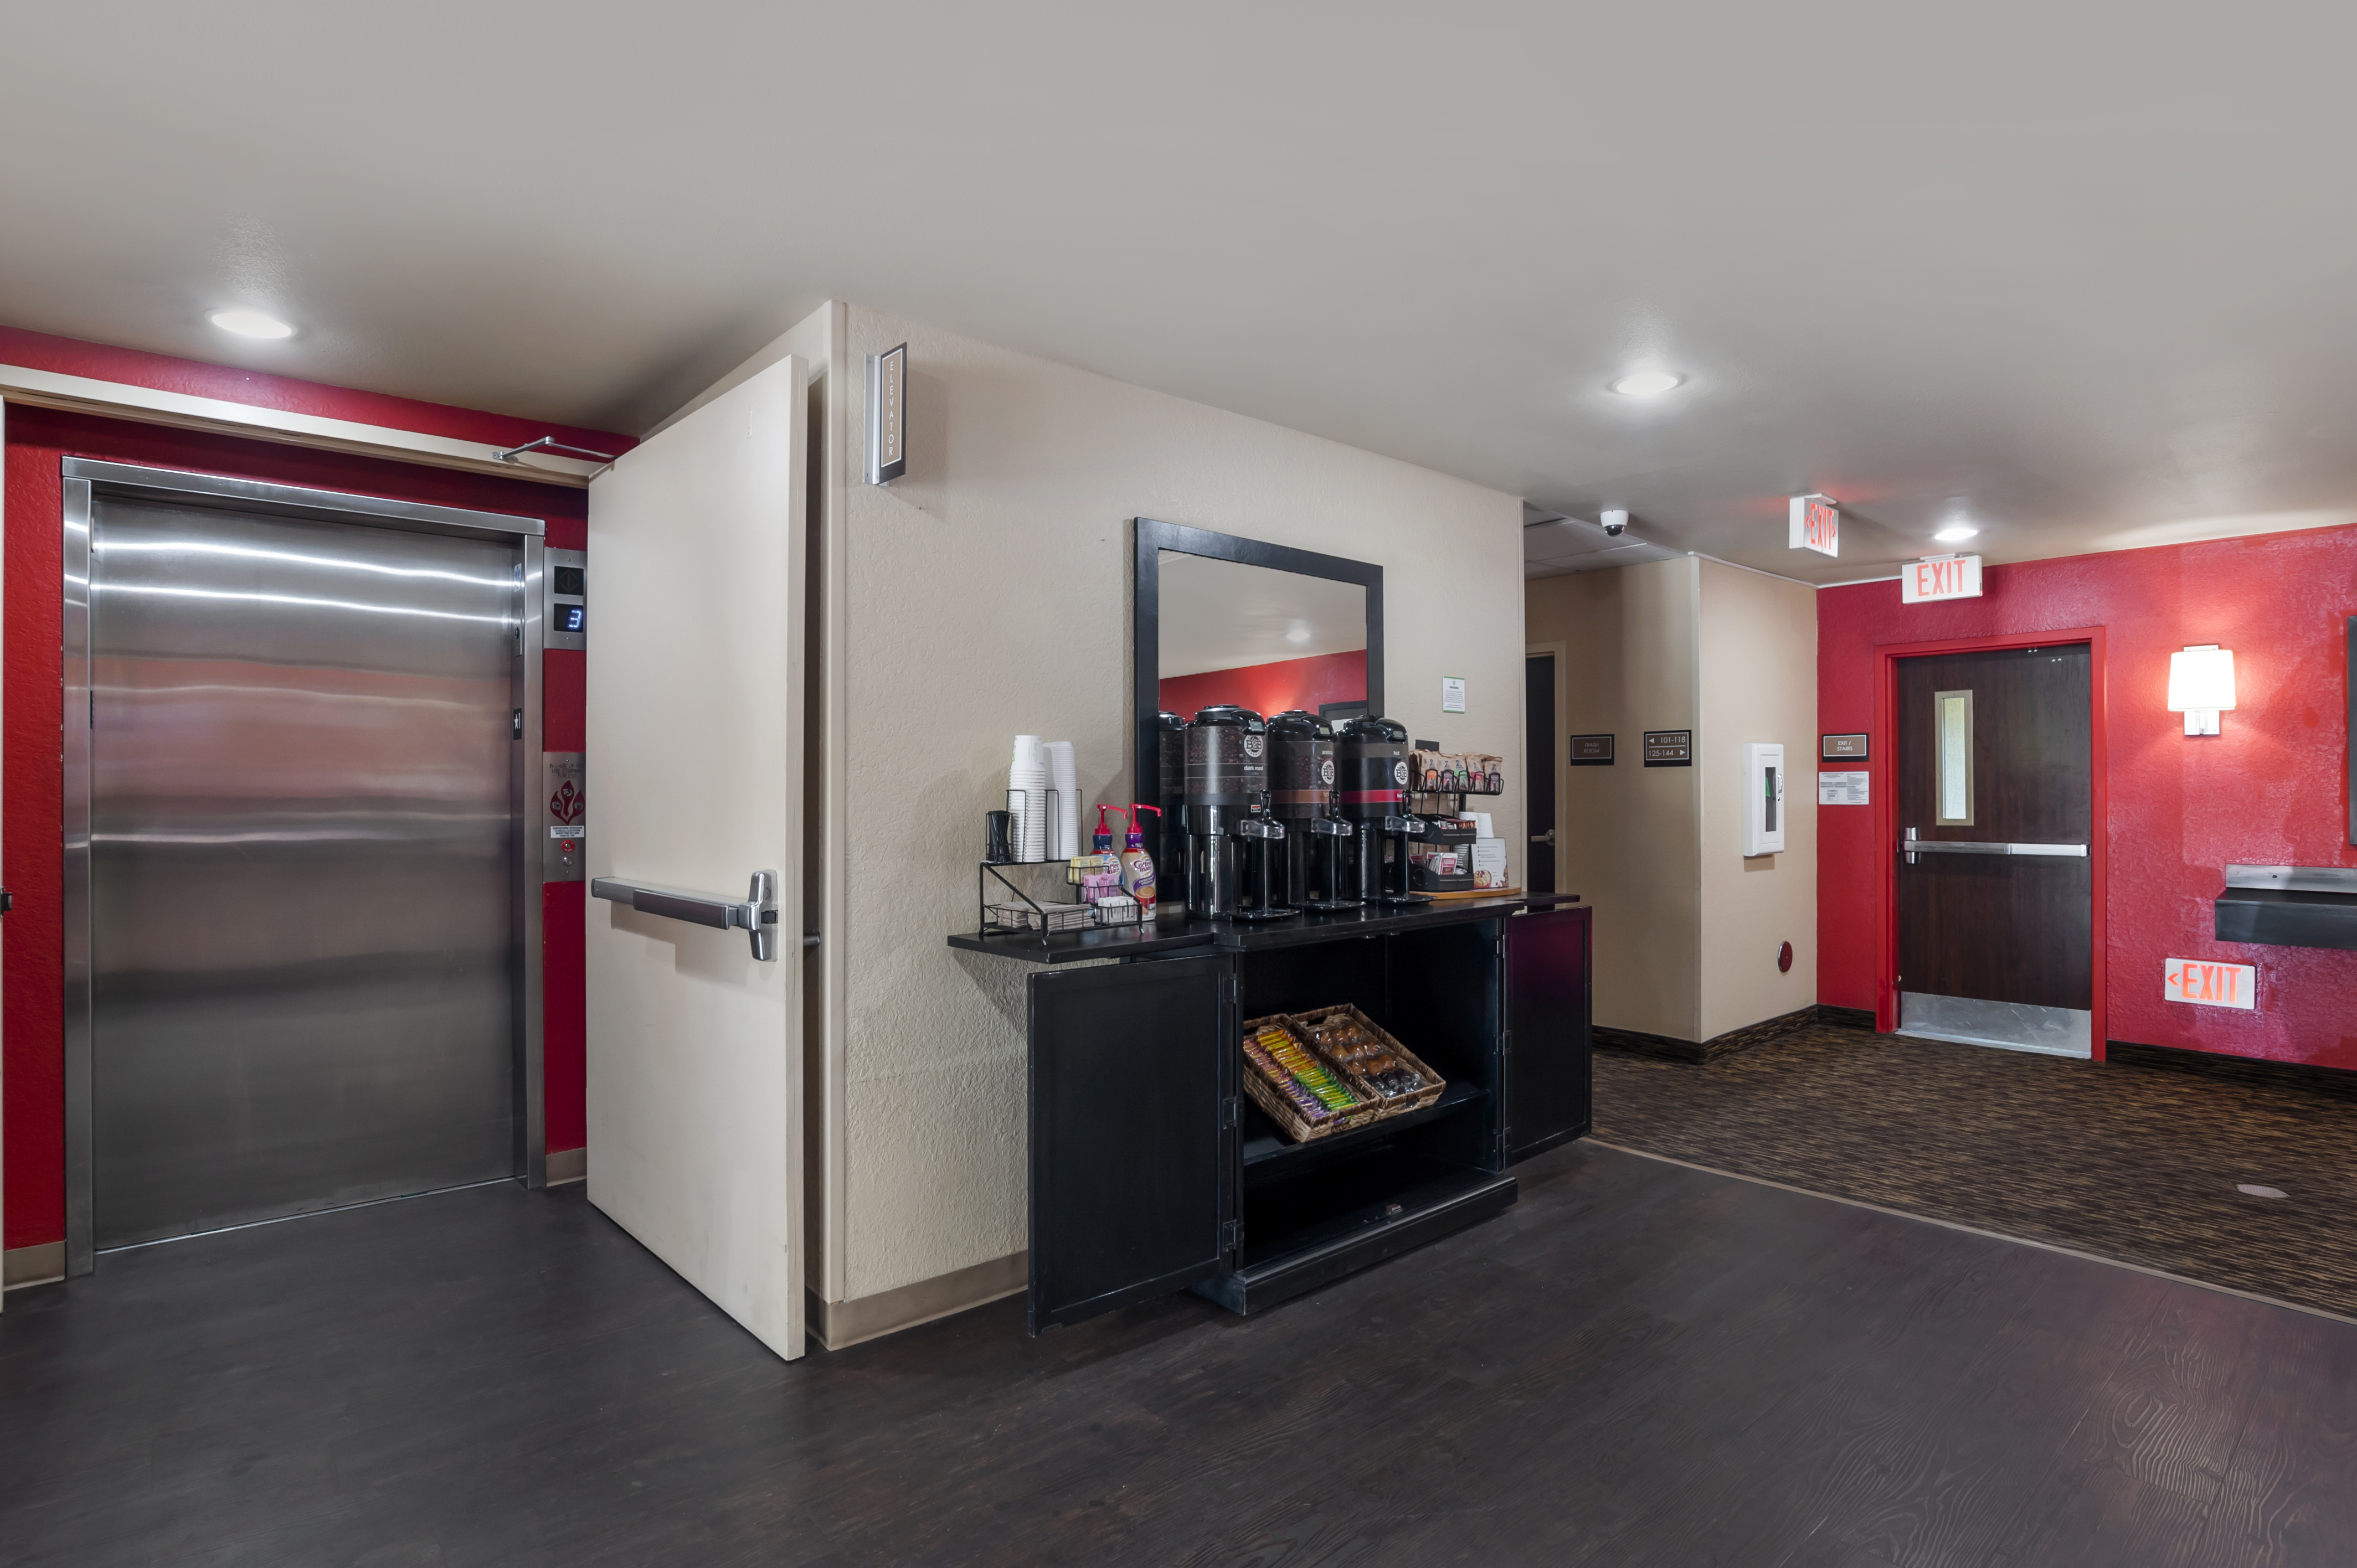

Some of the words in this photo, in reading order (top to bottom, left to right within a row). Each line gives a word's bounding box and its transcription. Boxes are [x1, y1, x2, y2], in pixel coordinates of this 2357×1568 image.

[1810, 503, 1834, 551] EXIT
[1916, 559, 1967, 597] EXIT
[568, 610, 581, 628] 3
[2181, 963, 2242, 1004] EXIT
